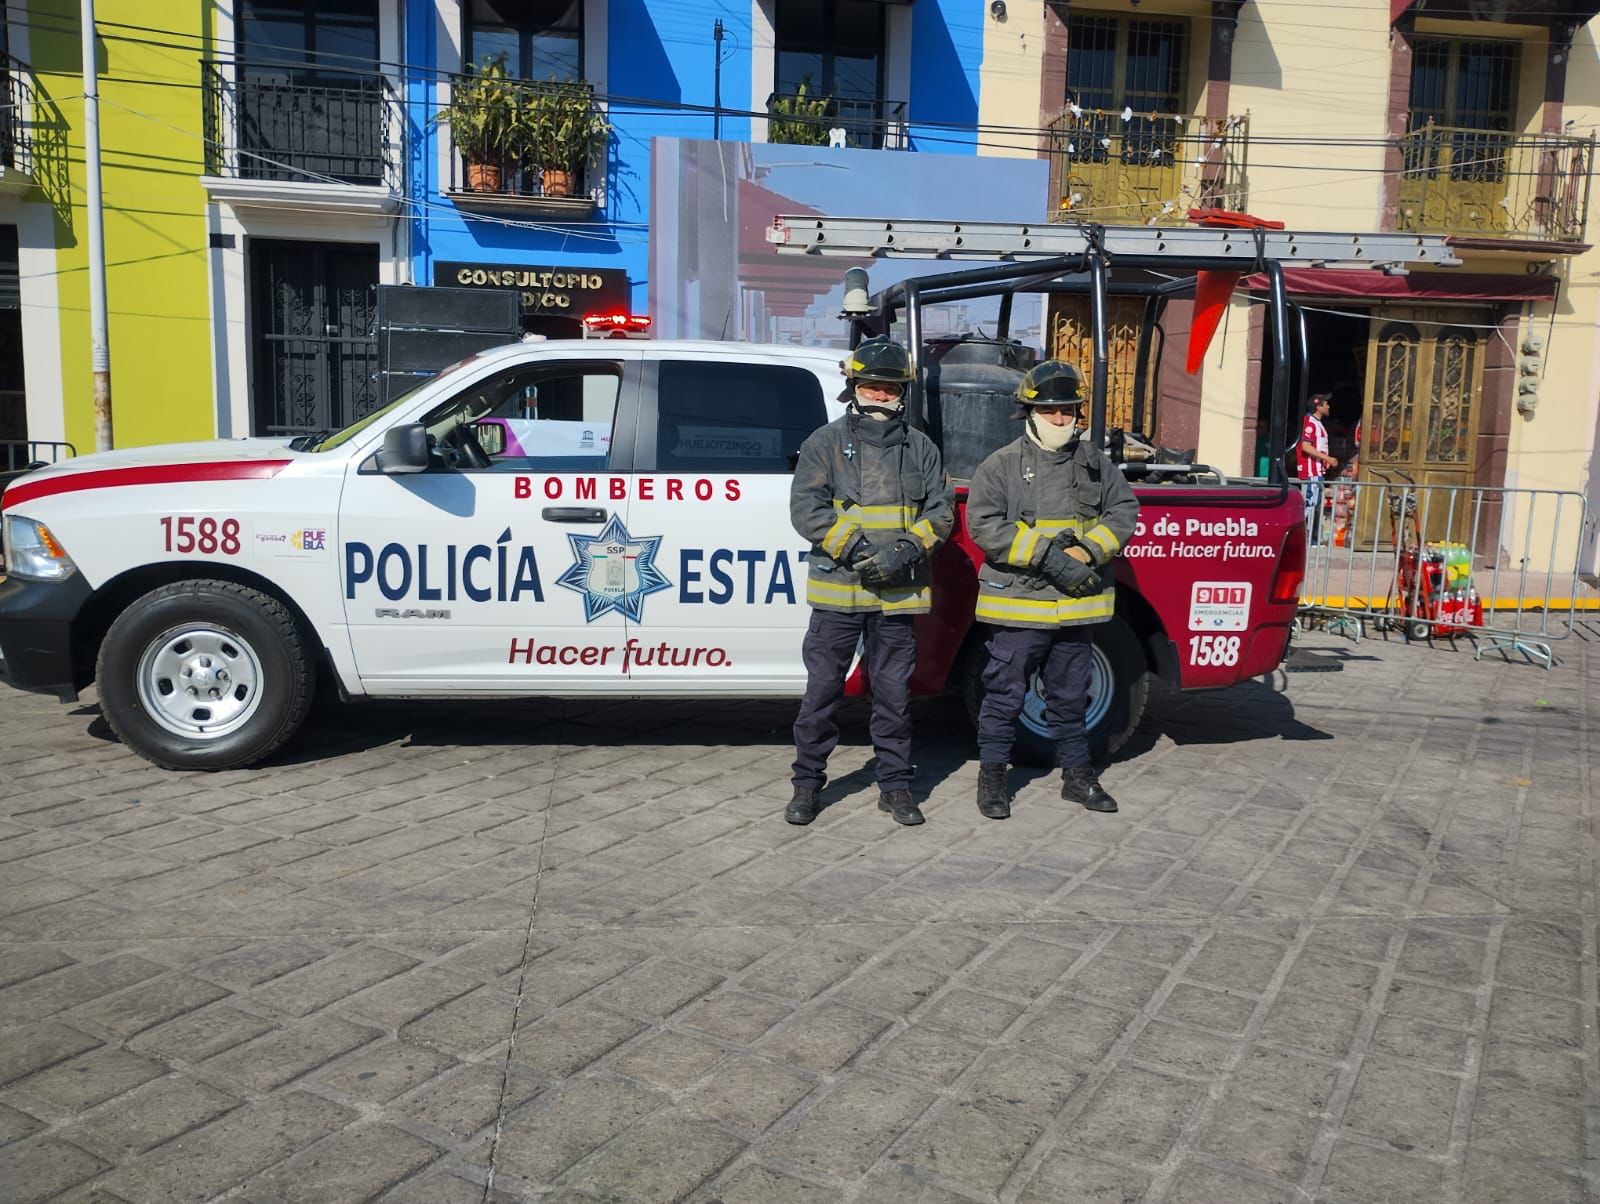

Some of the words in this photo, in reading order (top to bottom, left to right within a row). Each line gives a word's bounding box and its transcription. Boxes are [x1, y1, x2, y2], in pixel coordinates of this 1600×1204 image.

[521, 291, 571, 308] DICO
[514, 476, 741, 502] BOMBEROS
[160, 516, 241, 555] 1588
[1153, 517, 1180, 537] de
[1185, 517, 1259, 537] Puebla
[606, 546, 625, 554] SSP
[1170, 541, 1220, 558] Hacer
[1222, 540, 1276, 562] futuro.
[345, 526, 545, 603] POLICÍA
[679, 548, 809, 605] ESTA
[1198, 589, 1242, 603] 911
[375, 608, 451, 619] RAM
[508, 637, 615, 665] Hacer
[621, 638, 733, 674] futuro.
[1189, 635, 1241, 667] 1588
